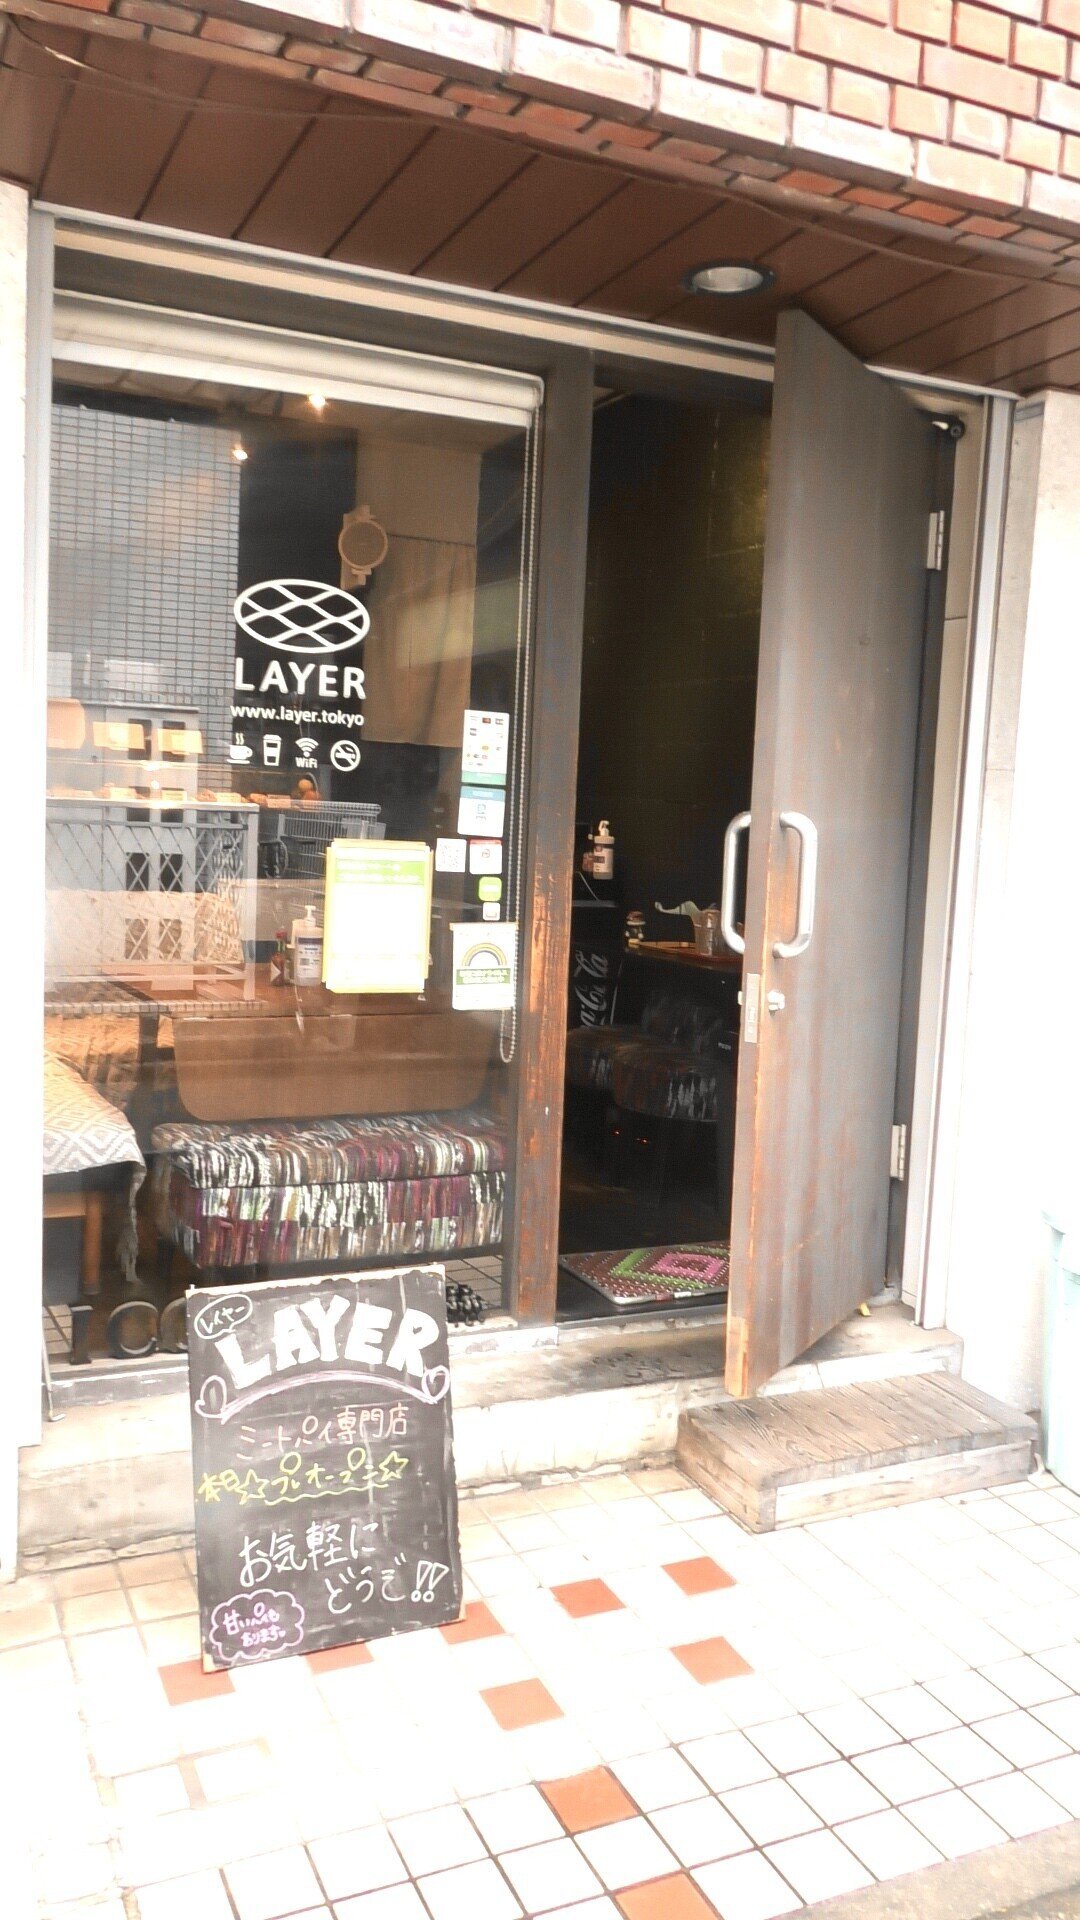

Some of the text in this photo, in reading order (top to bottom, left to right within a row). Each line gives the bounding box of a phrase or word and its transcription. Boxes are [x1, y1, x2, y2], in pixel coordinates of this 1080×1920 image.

[234, 657, 366, 699] LAYER
[230, 705, 364, 728] www.layer.tokyo
[295, 756, 318, 768] WiFi
[199, 1305, 245, 1333] レイヤー
[215, 1295, 439, 1389] LAYER
[236, 1403, 408, 1460] ミートパイ専門店
[239, 1521, 378, 1587] お気軽に
